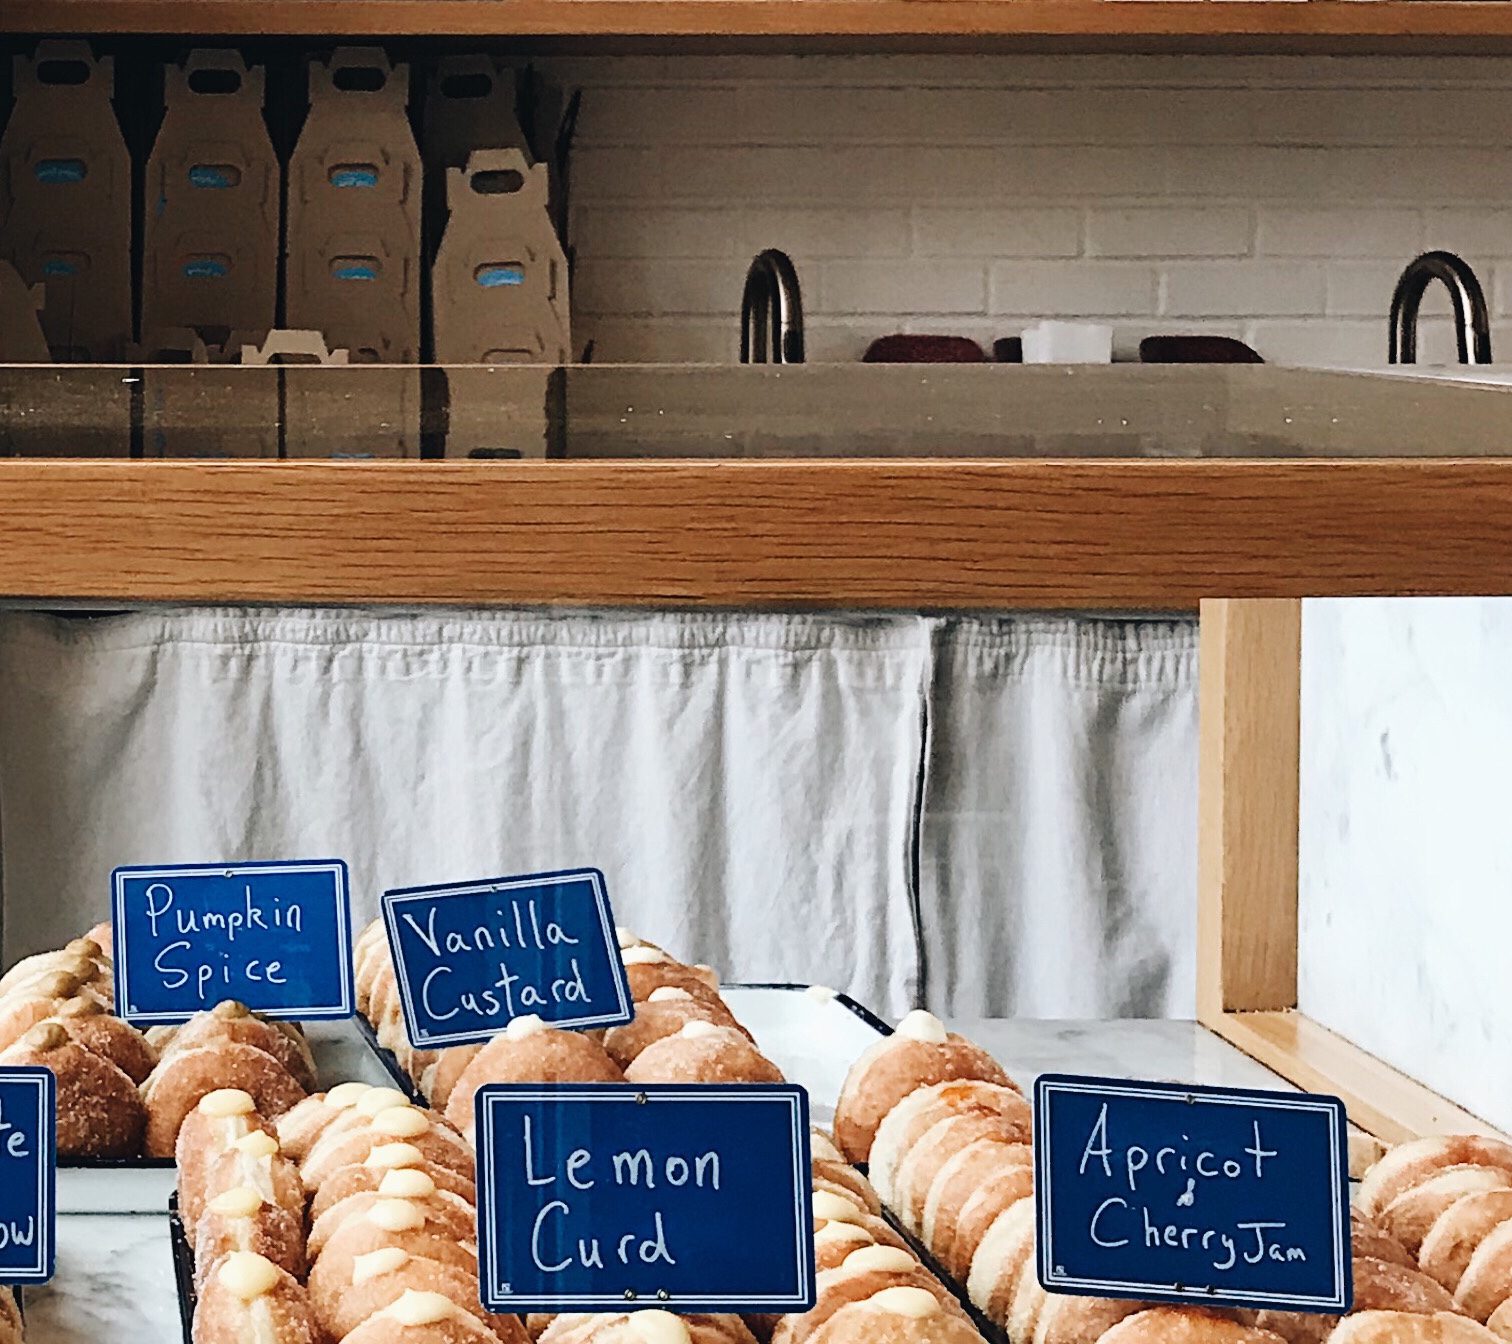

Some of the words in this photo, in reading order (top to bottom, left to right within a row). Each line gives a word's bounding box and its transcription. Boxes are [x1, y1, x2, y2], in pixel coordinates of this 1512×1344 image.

[145, 883, 301, 941] Pumpkin
[402, 899, 579, 957] Vanilla
[154, 941, 287, 1000] Spice
[422, 958, 596, 1025] Custard
[523, 1114, 720, 1191] Lemon
[1079, 1102, 1278, 1195] Apricot
[531, 1200, 676, 1272] Curd
